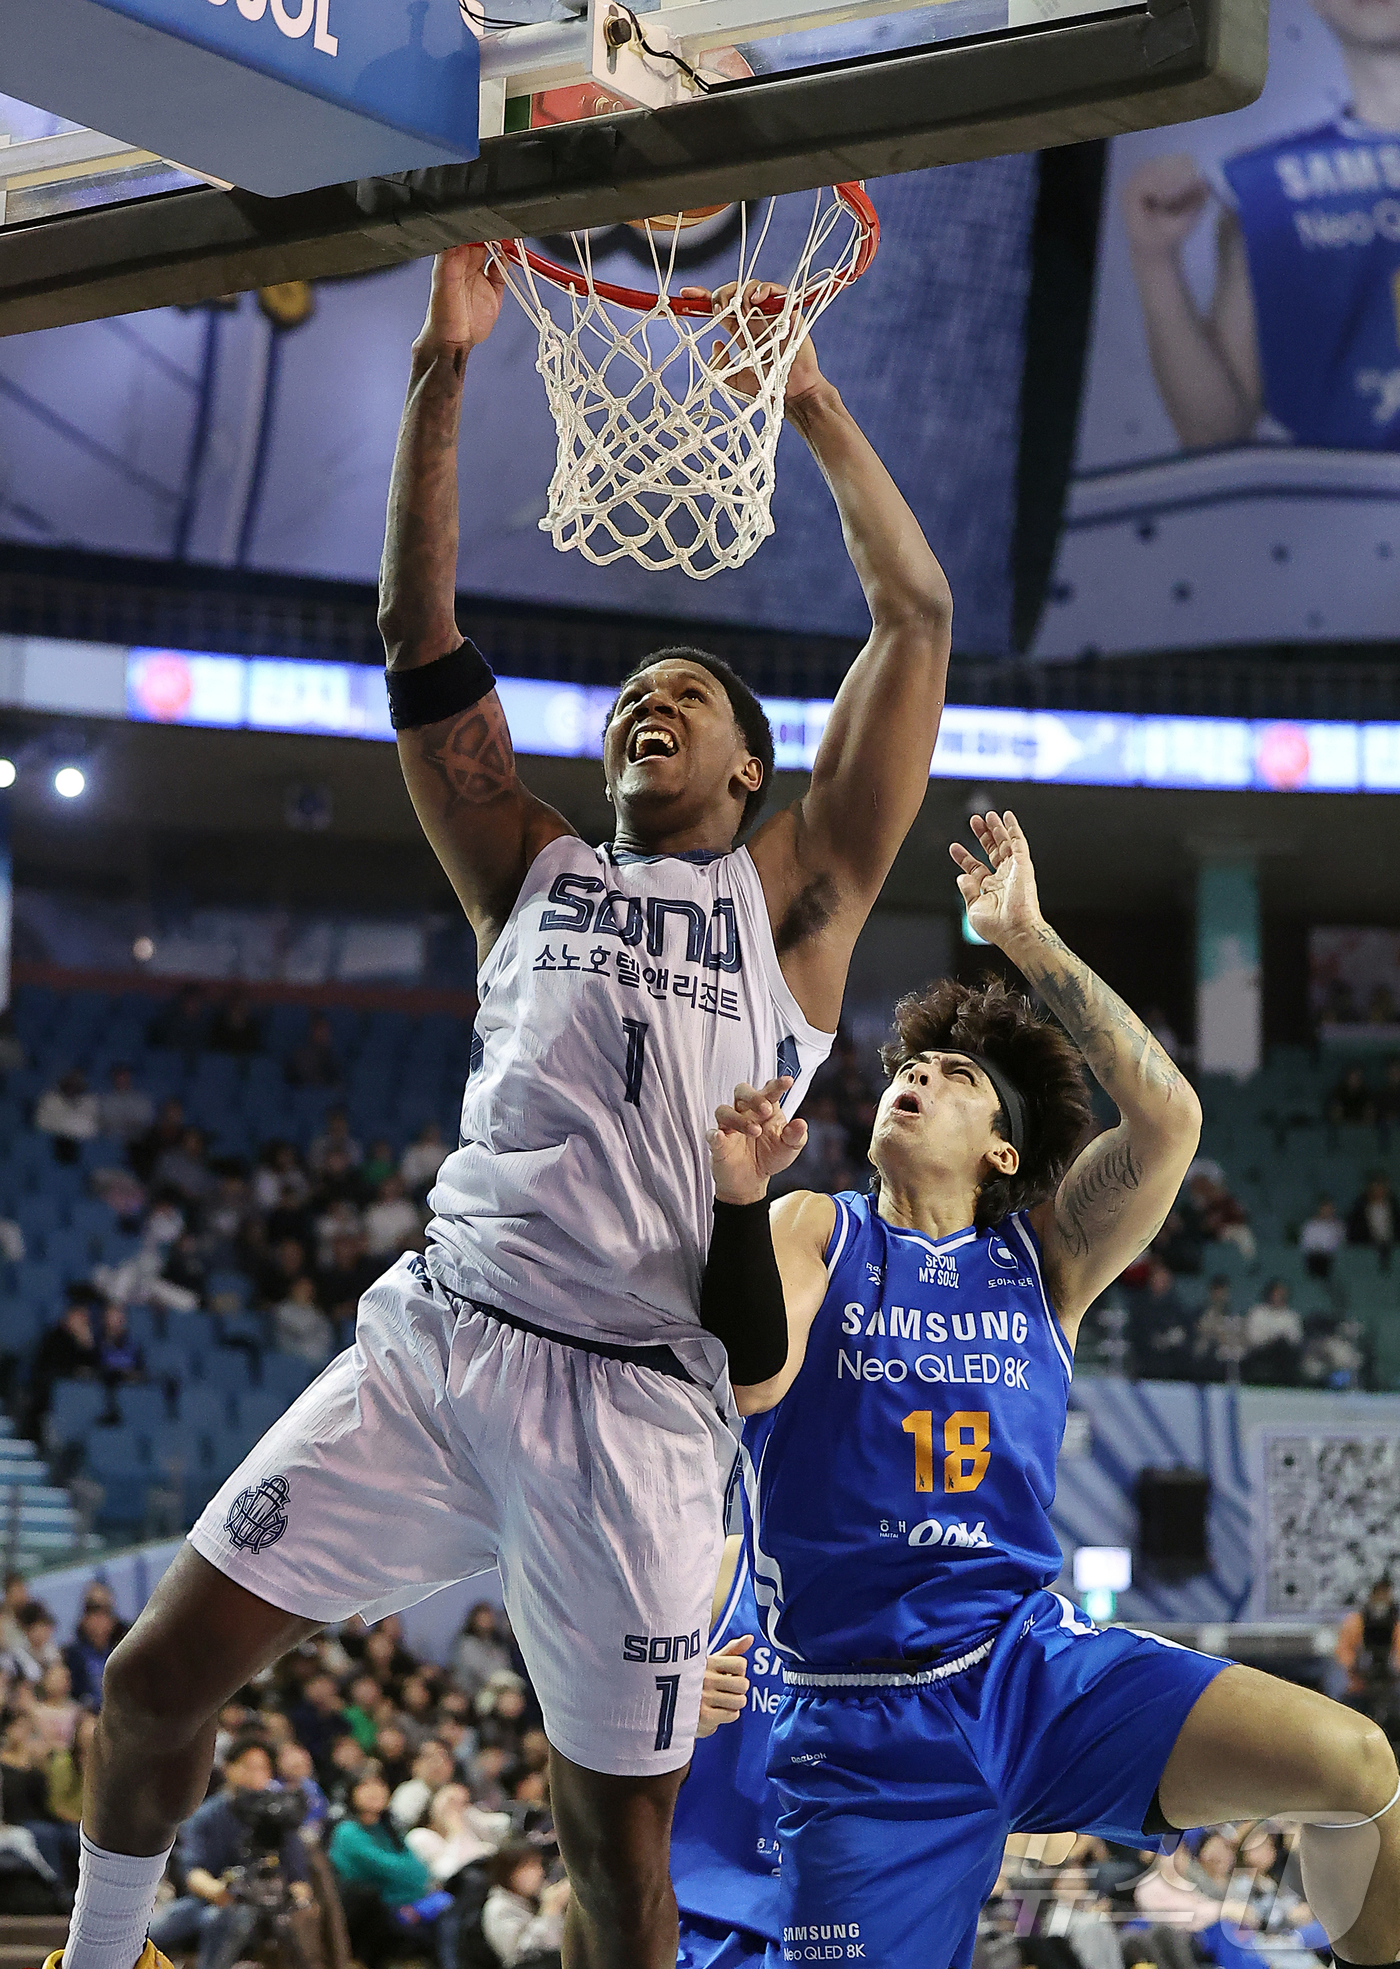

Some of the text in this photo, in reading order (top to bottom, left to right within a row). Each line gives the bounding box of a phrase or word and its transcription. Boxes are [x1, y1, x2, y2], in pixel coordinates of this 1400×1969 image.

[622, 1016, 649, 1107] 1
[937, 1269, 960, 1289] SOUL
[841, 1302, 1028, 1344] SAMSUNG
[838, 1348, 1030, 1391] Neo QLED 8K
[901, 1410, 991, 1493] 18
[654, 1673, 681, 1751] 1
[783, 1922, 860, 1942] SAMSUNG
[783, 1943, 867, 1962] Neo QLED 8K
